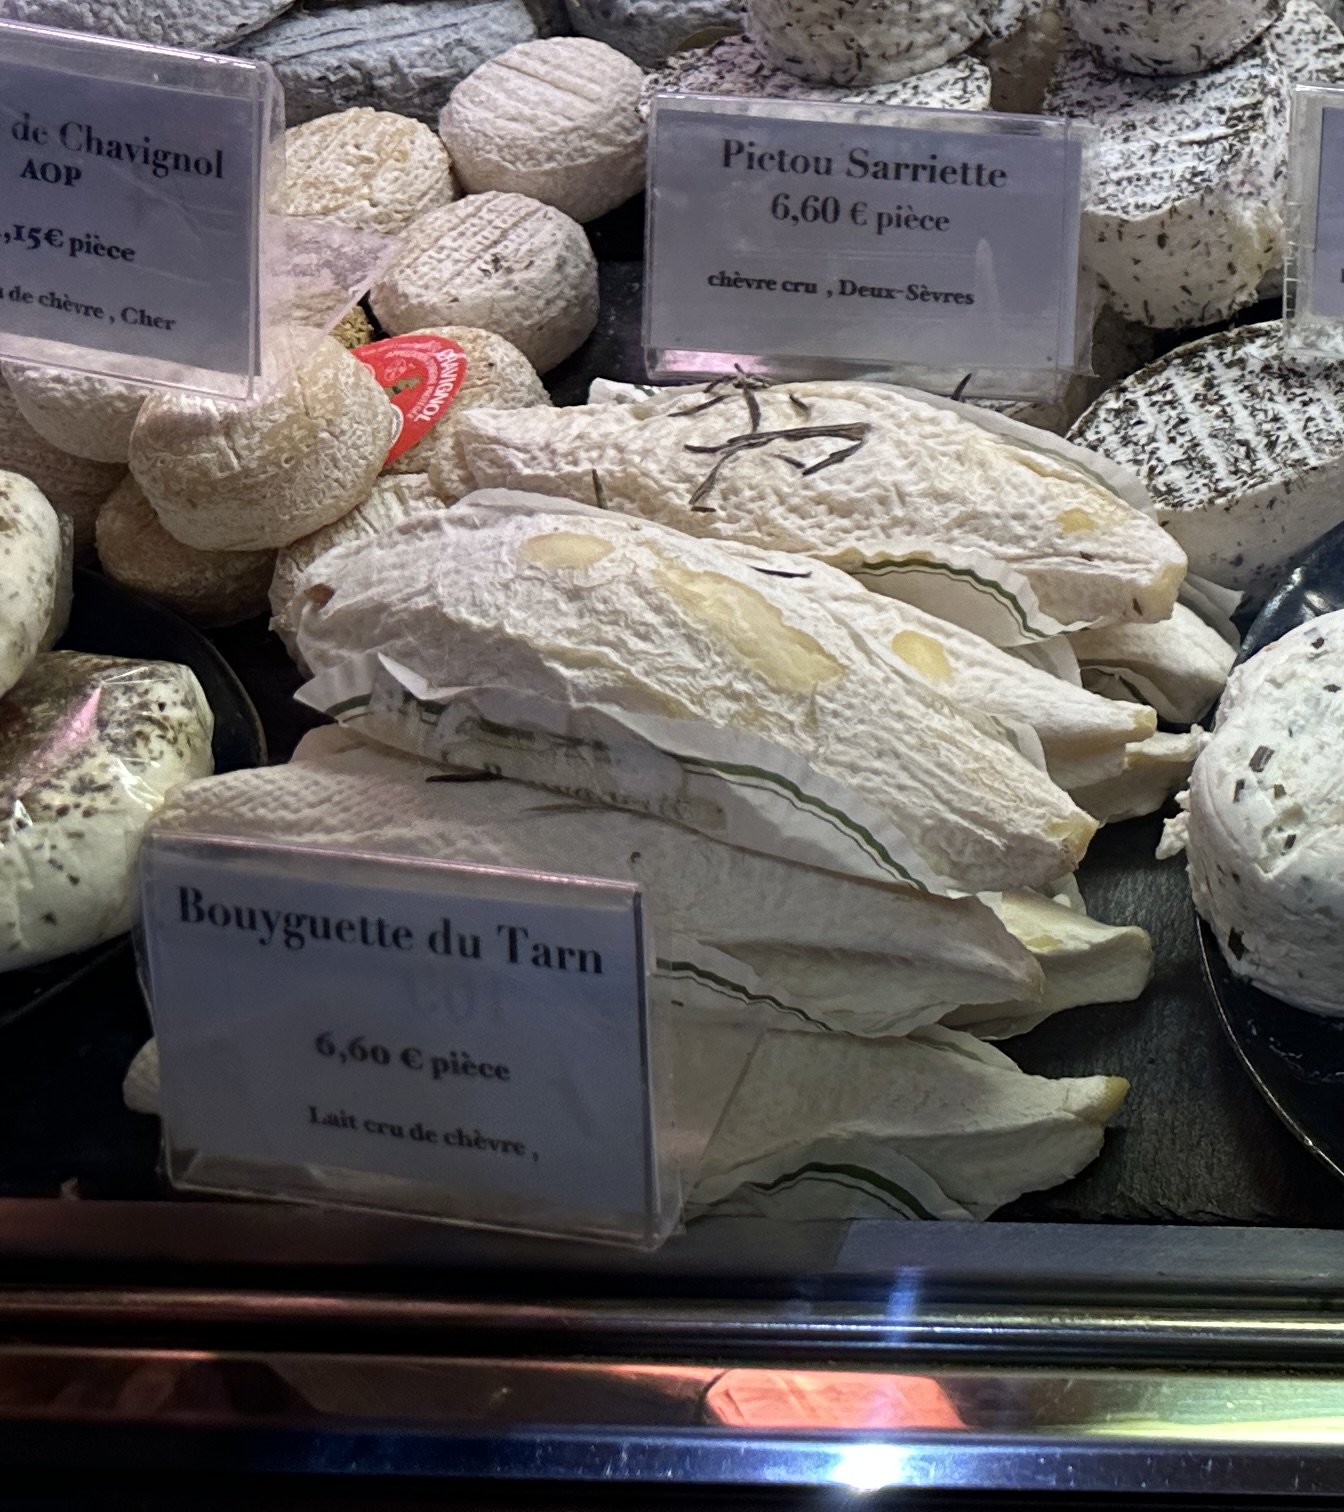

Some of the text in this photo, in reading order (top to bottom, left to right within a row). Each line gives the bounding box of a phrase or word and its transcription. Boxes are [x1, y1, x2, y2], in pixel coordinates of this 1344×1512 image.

[11, 111, 225, 179] de Chavignol
[845, 146, 1008, 189] Sarriette
[20, 157, 83, 187] AOP
[771, 192, 951, 236] 6,60 € pièce
[176, 885, 605, 975] Bouyguette du Tarn
[314, 1030, 511, 1083] 6,60 € pièce
